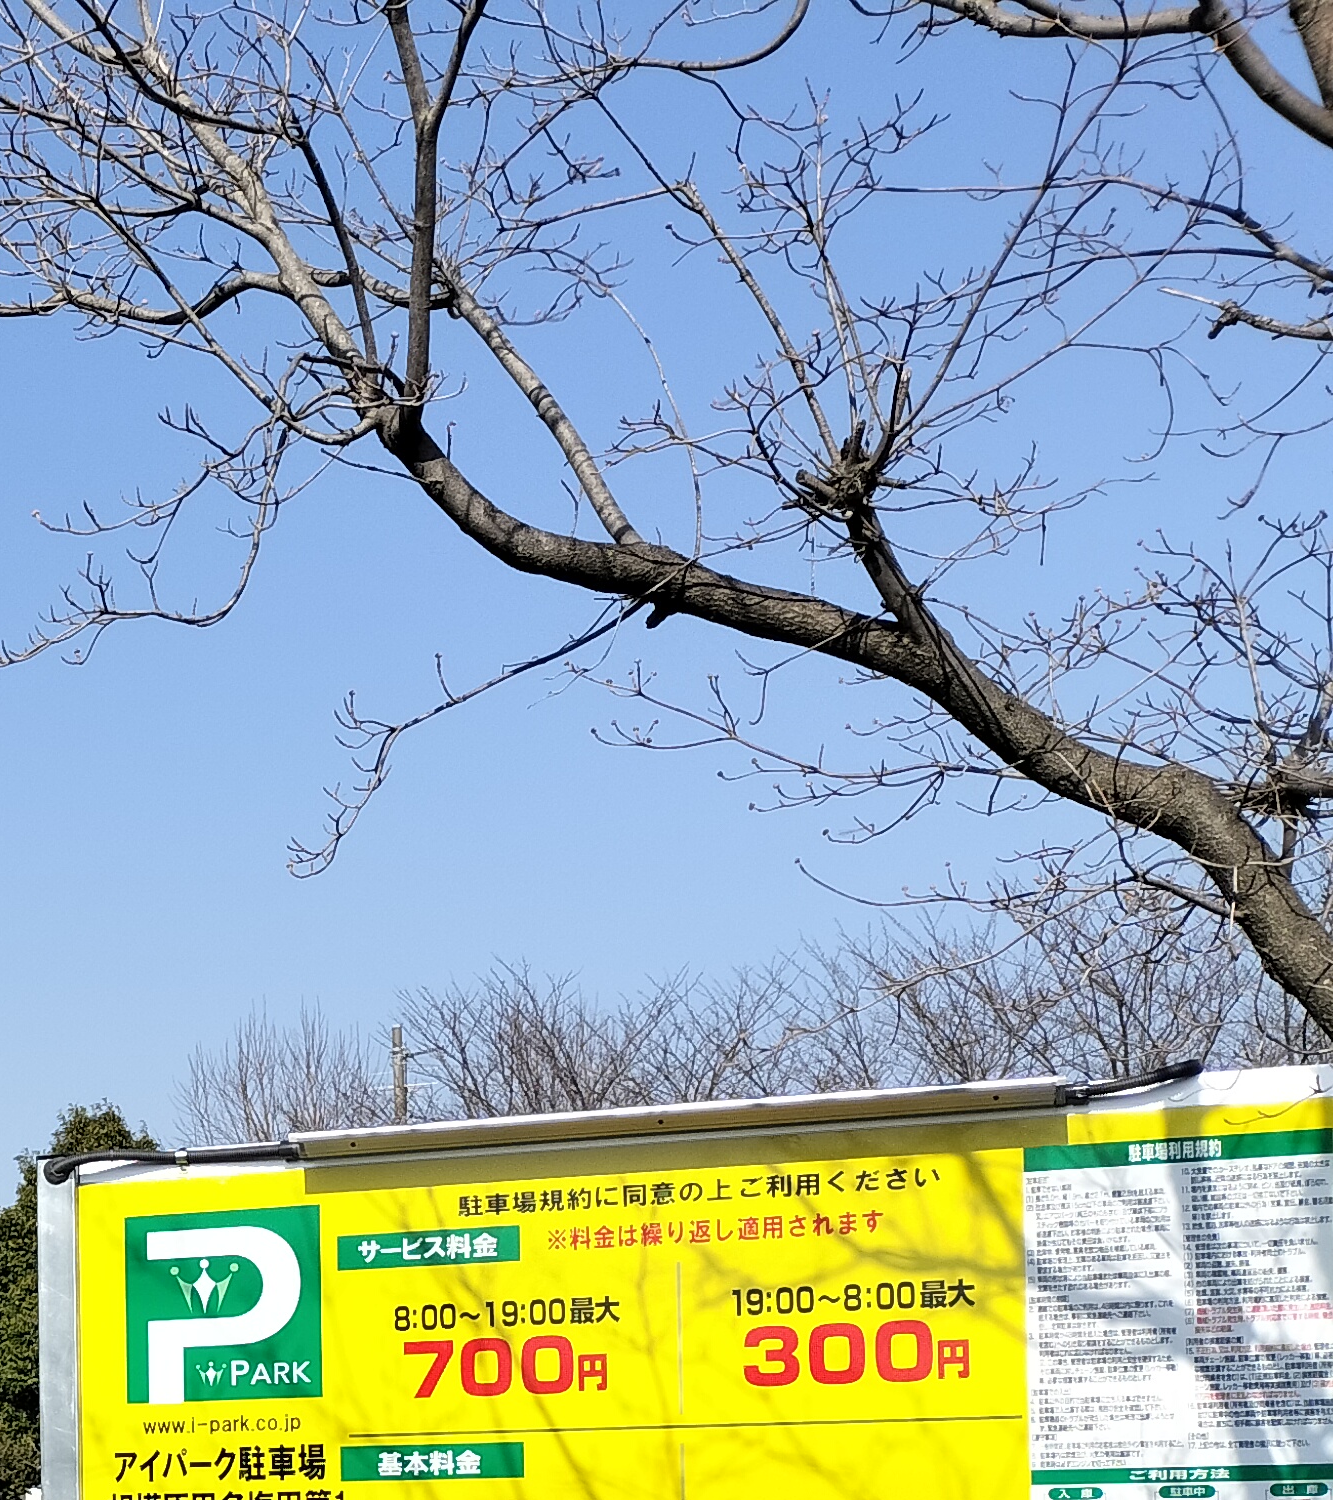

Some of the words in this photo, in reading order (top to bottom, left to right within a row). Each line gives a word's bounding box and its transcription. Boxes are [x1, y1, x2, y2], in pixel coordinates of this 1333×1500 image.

[1128, 1139, 1222, 1162] 駐車場利用規約
[458, 1167, 941, 1217] 駐車場規約に同意の上ご利用ください
[547, 1209, 884, 1251] ※料金は繰り返し適用されます
[357, 1232, 499, 1263] サービス料金
[403, 1335, 608, 1399] 700円
[743, 1319, 970, 1387] 300円
[230, 1359, 312, 1387] PARK
[143, 1414, 302, 1435] www.i-park.co.jp
[114, 1444, 327, 1483] アイパーク駐車場
[377, 1449, 482, 1477] 基本料金
[1129, 1468, 1230, 1480] ご利用方法
